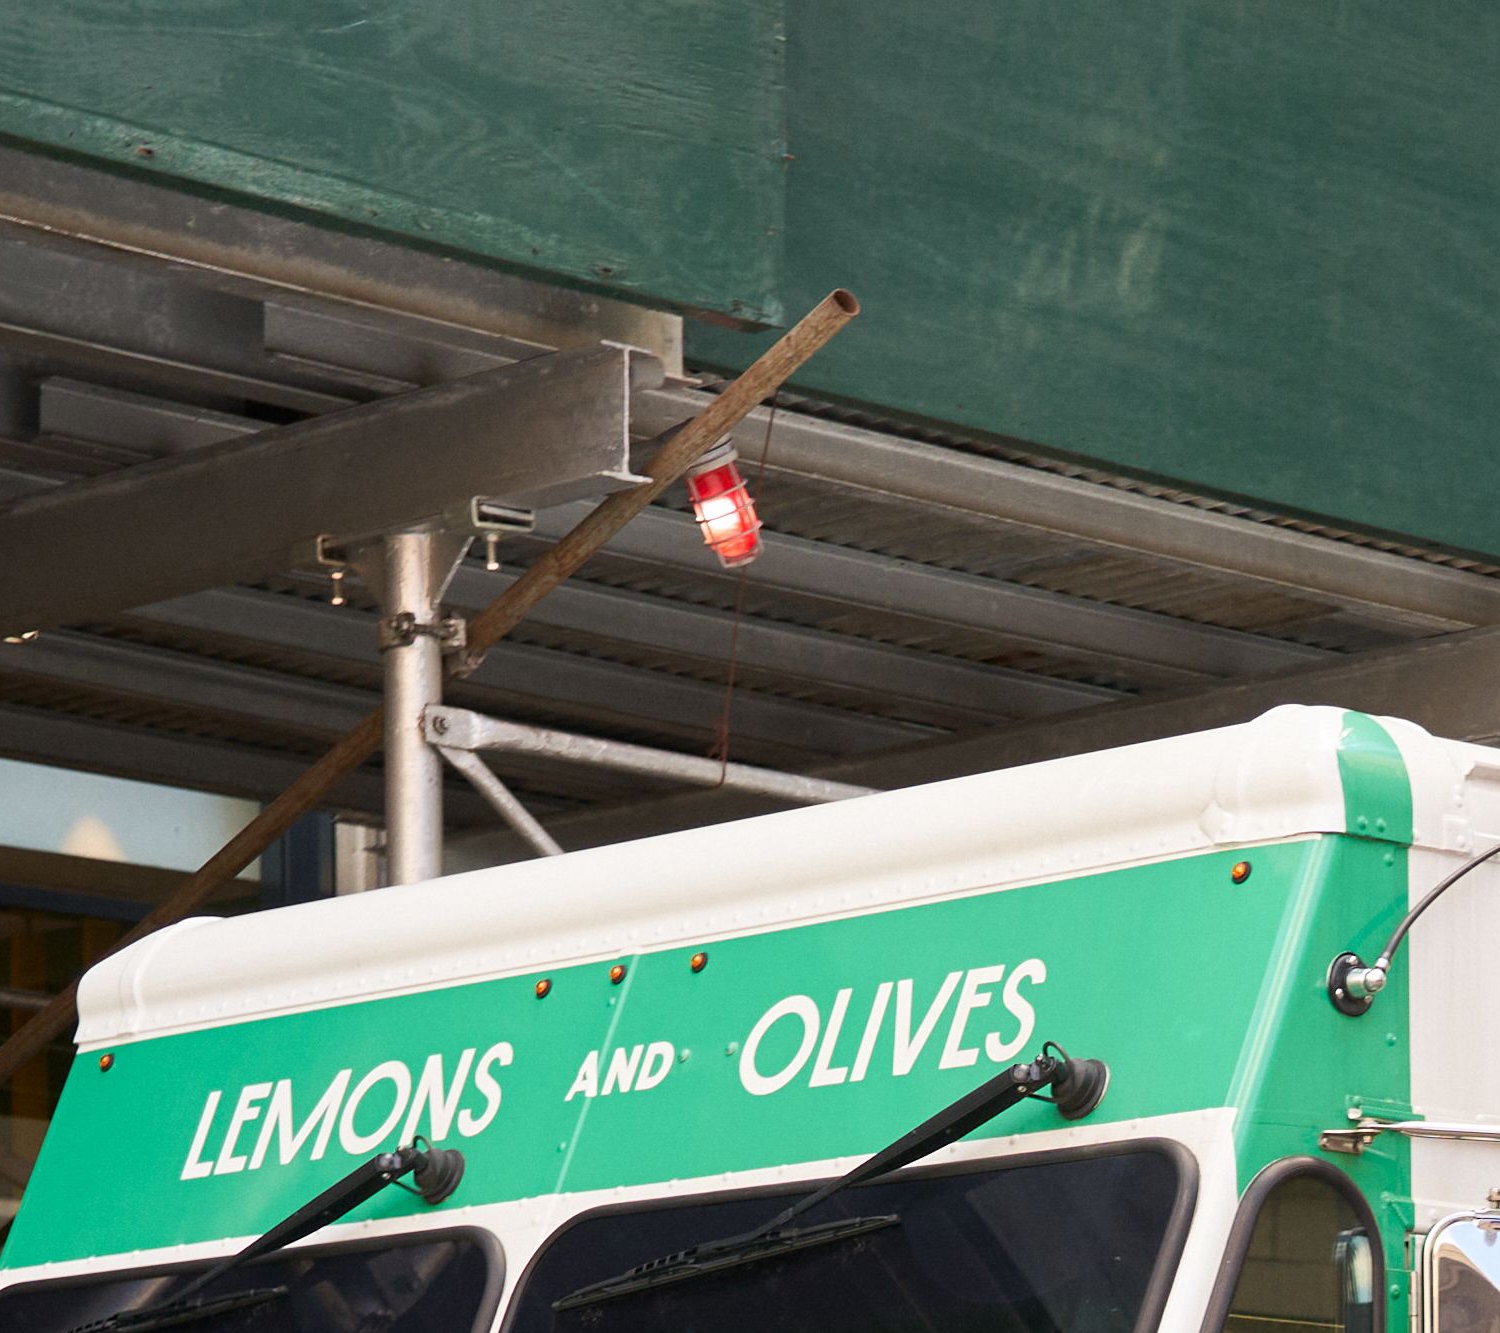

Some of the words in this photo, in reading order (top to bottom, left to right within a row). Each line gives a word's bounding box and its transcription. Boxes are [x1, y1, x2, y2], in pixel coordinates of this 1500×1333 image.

[179, 1040, 515, 1182] LEMONS
[563, 1040, 676, 1103] AND
[737, 957, 1047, 1097] OLIVES
